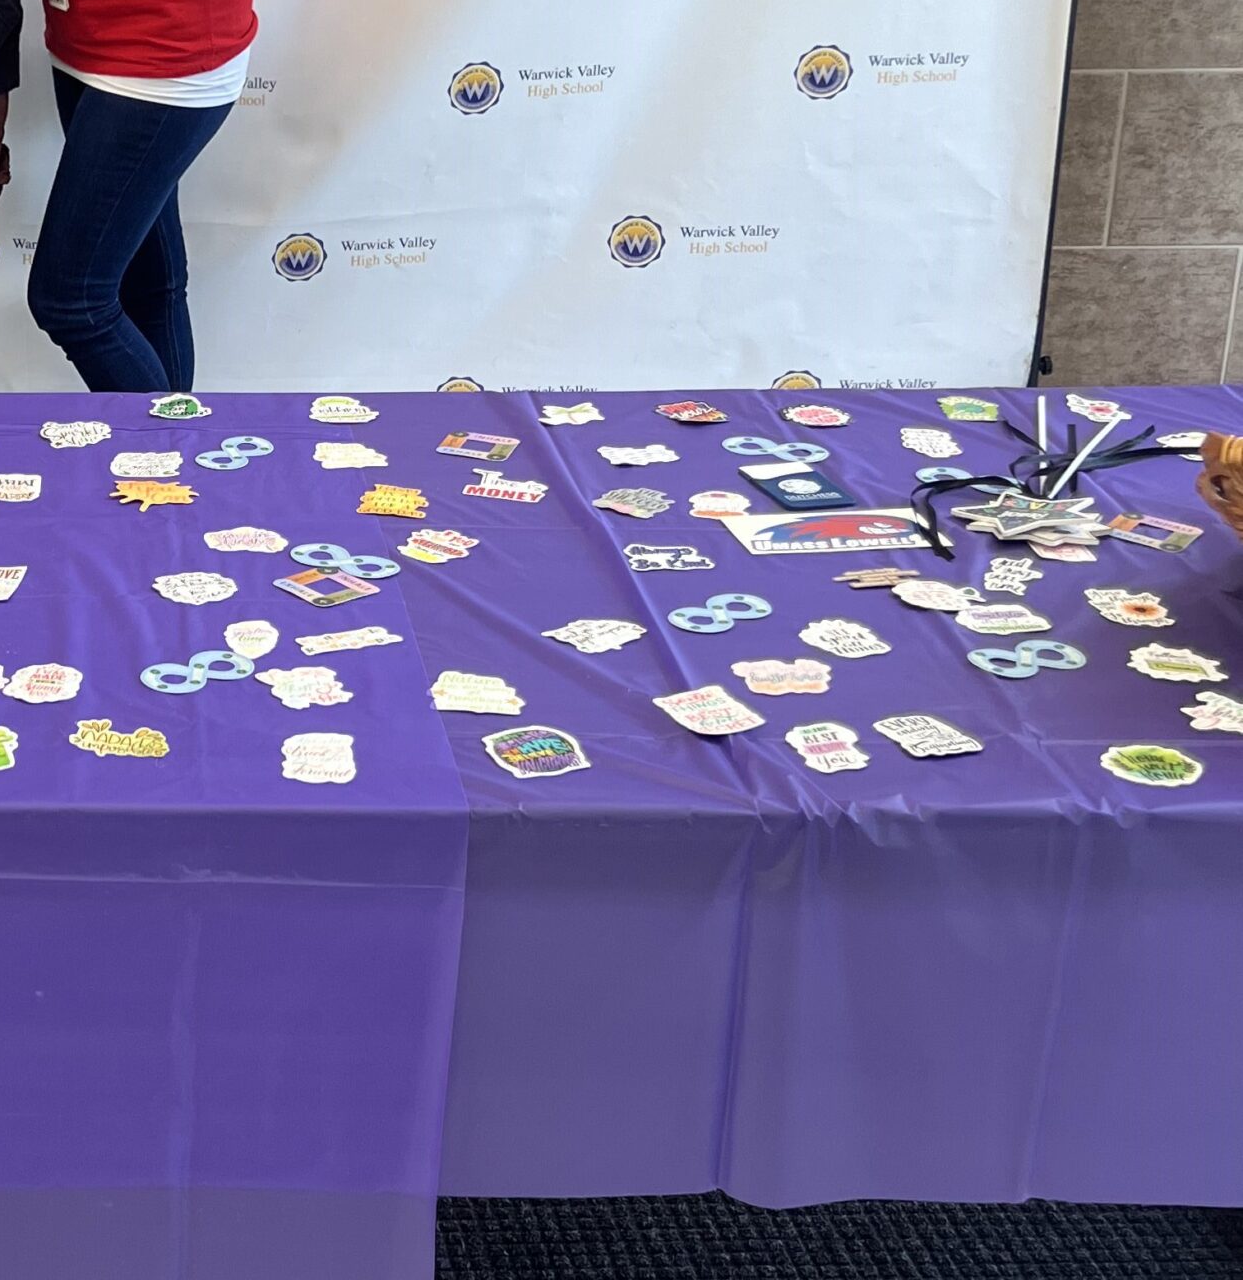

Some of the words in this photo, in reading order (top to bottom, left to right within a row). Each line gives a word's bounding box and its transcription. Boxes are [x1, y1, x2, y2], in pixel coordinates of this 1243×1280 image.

[869, 54, 925, 66] Warwick
[930, 53, 969, 67] Valley
[519, 68, 572, 81] Warwick
[578, 65, 615, 80] Valley
[877, 71, 909, 85] High
[912, 69, 957, 83] School
[528, 84, 557, 99] High
[561, 82, 604, 95] School
[680, 226, 735, 238] Warwick
[741, 225, 779, 239] Valley
[690, 243, 719, 256] High
[724, 242, 768, 253] School
[465, 486, 541, 502] MONEY
[685, 707, 732, 722] BEST
[880, 716, 932, 730] EVERY
[803, 732, 839, 744] BEST
